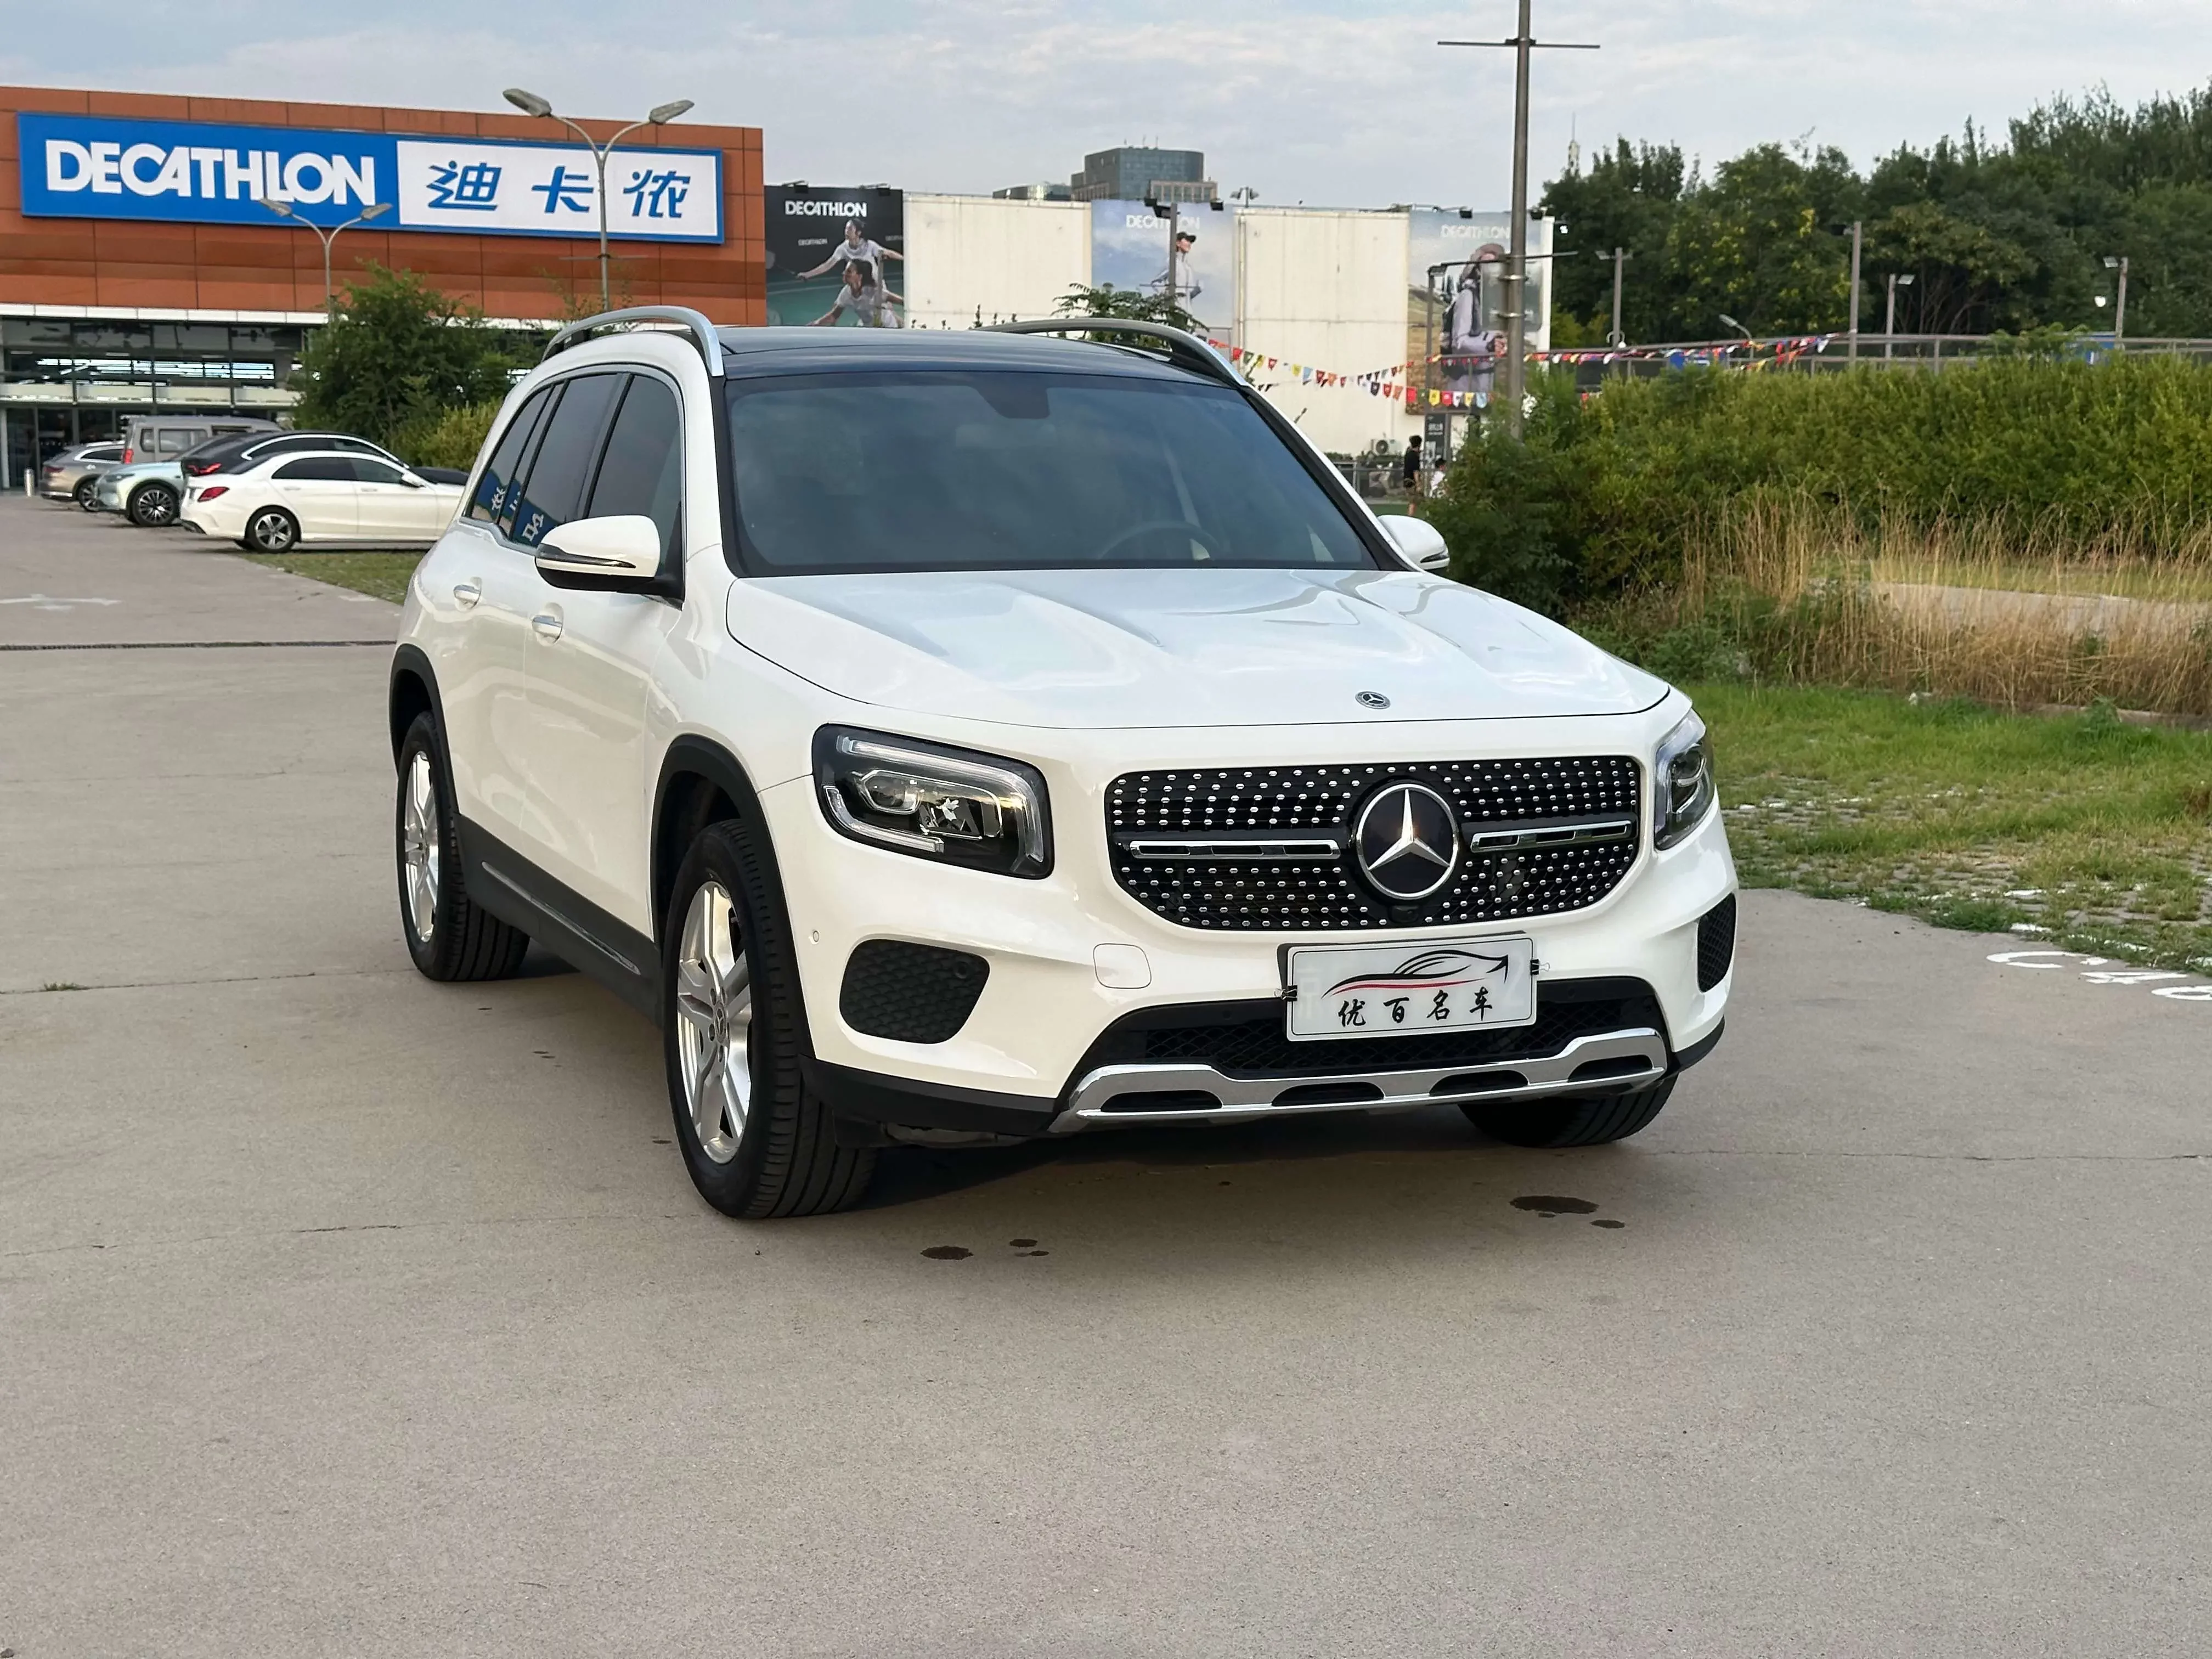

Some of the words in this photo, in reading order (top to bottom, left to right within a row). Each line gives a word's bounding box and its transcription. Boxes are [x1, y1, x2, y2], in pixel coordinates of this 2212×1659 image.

[46, 139, 376, 206] DECATHLON
[427, 160, 691, 218] 迪卡侬
[785, 200, 867, 217] DECATHLON
[1126, 214, 1201, 230] DECATON
[1338, 986, 1493, 1028] 优百名车
